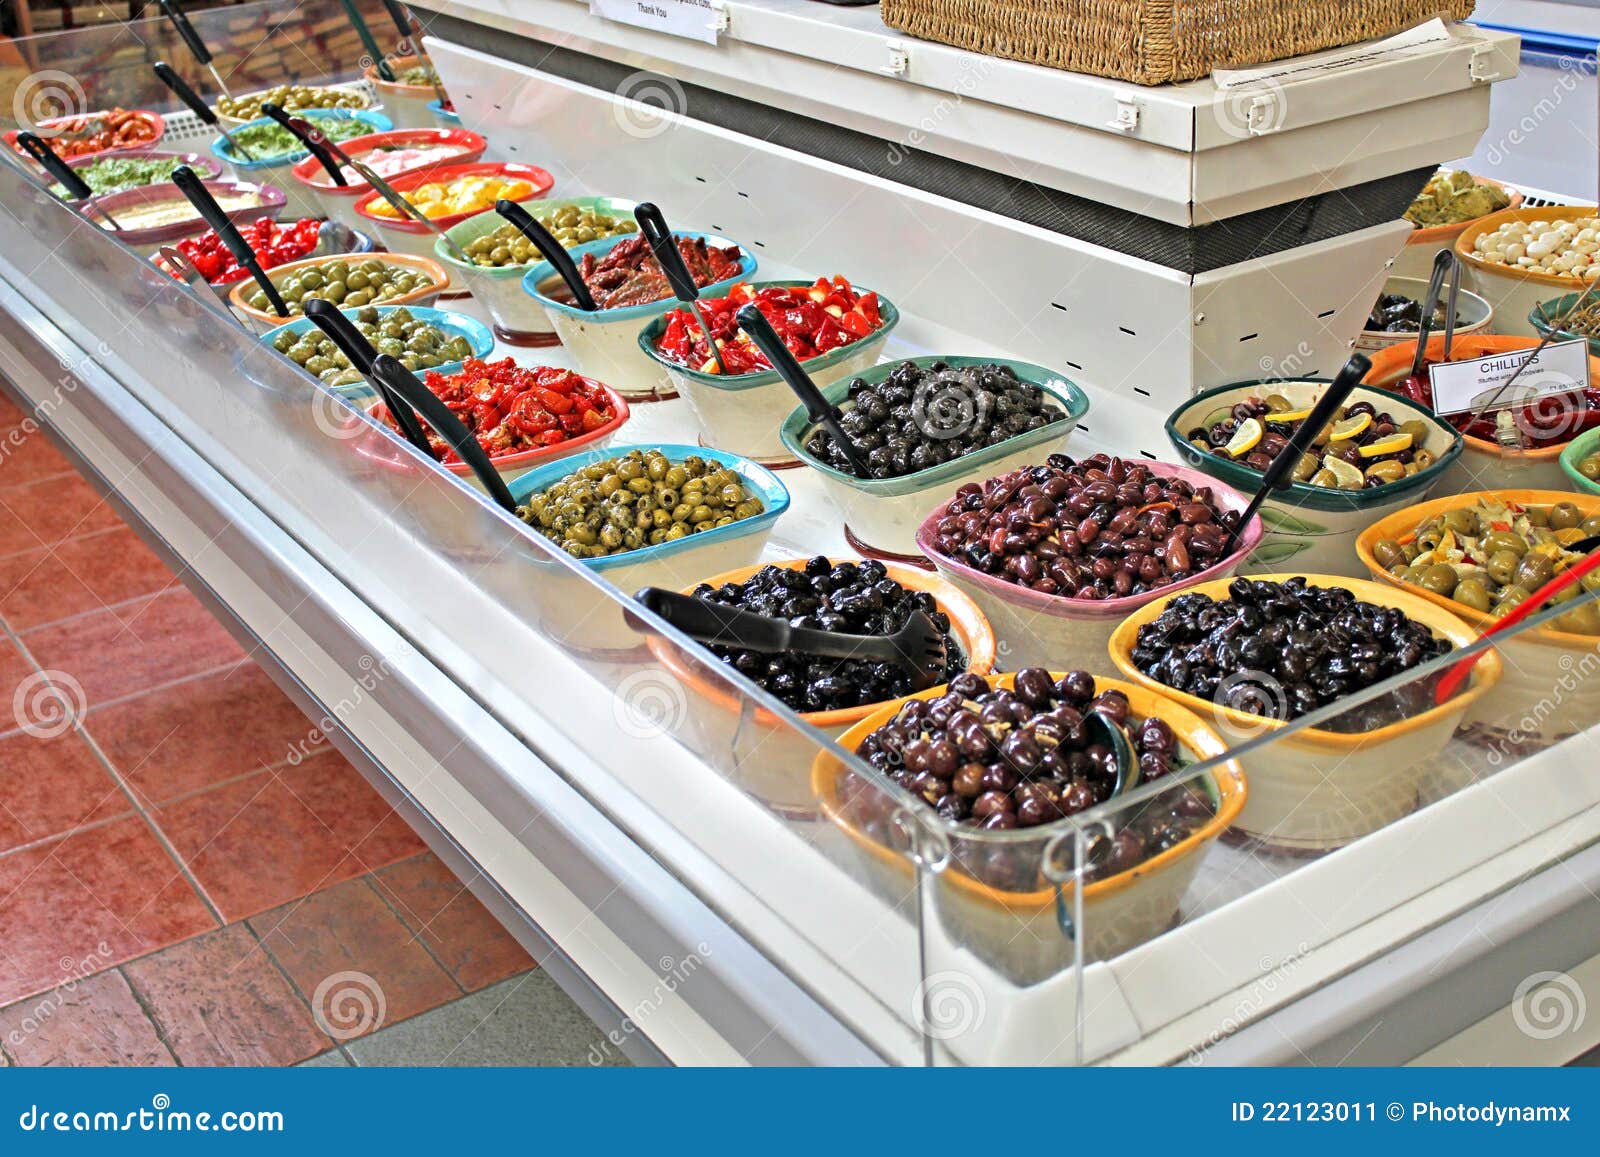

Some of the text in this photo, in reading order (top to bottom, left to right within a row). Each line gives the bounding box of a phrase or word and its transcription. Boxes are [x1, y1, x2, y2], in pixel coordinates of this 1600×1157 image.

[638, 3, 668, 18] Thank You
[1480, 354, 1540, 373] CHILLIES
